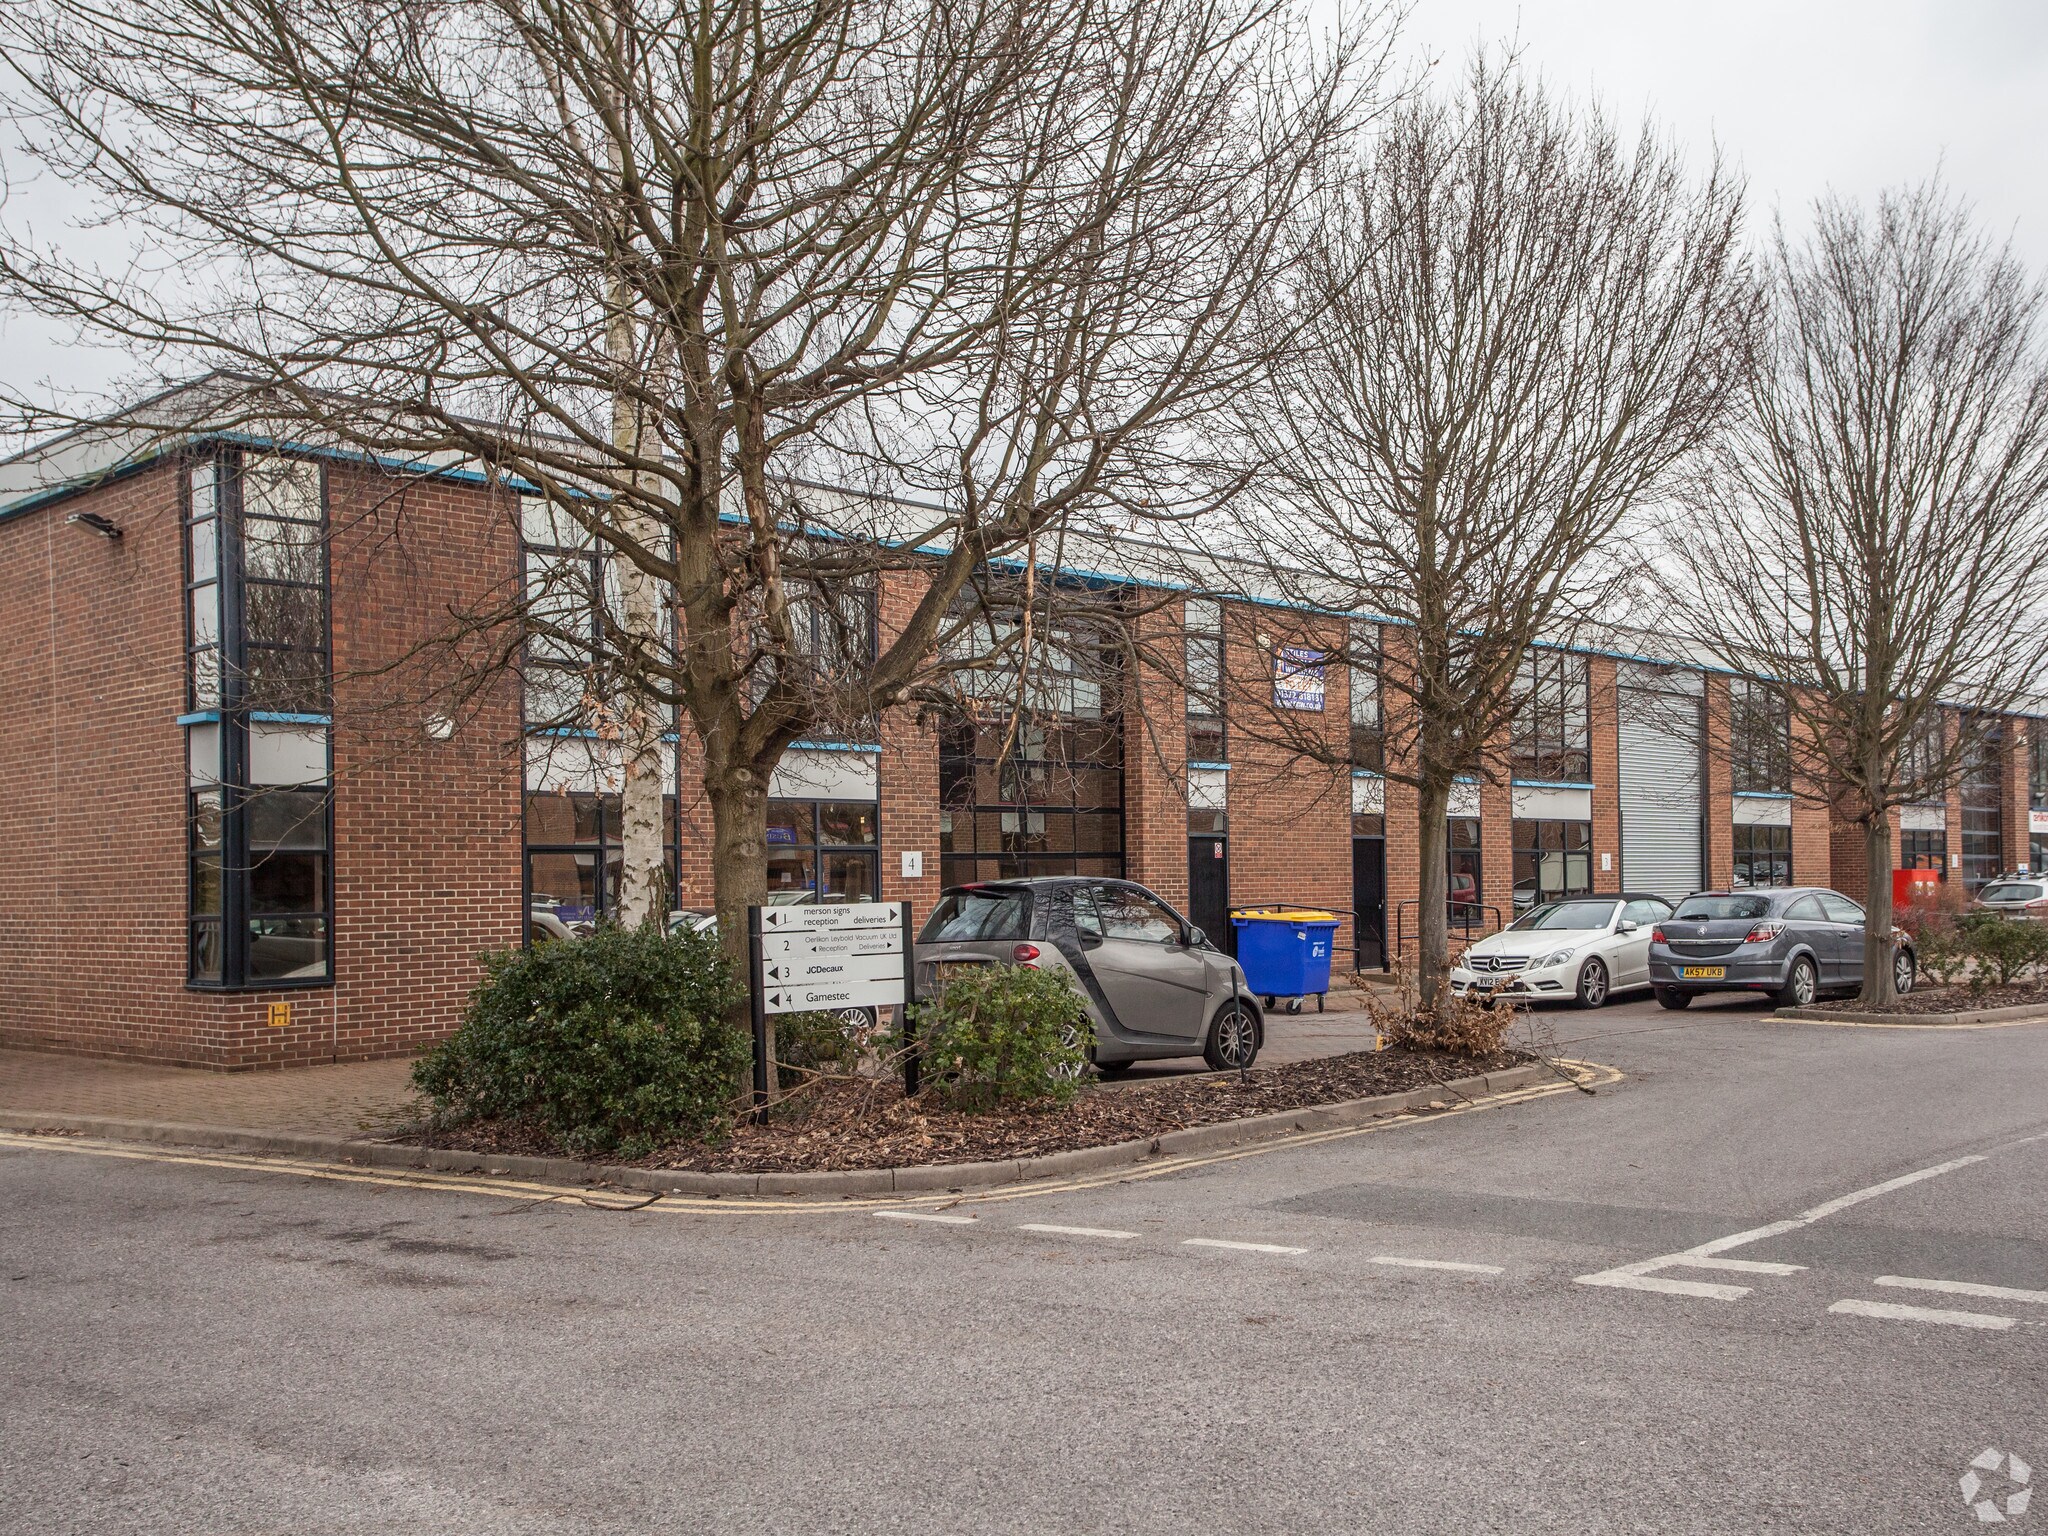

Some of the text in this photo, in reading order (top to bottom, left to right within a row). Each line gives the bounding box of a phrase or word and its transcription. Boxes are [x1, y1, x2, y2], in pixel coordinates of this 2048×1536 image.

[908, 857, 915, 870] 4
[833, 907, 850, 916] signs
[804, 915, 886, 927] reception deliveries
[805, 936, 830, 944] Oerlikon
[830, 934, 853, 942] Leybold
[784, 940, 790, 951] 2
[818, 942, 885, 952] Reception Deliveries
[784, 965, 844, 978] 3 JCDecaux
[1685, 968, 1705, 976] AK57
[786, 992, 850, 1004] 4 Gamestec
[272, 1005, 288, 1024] H
